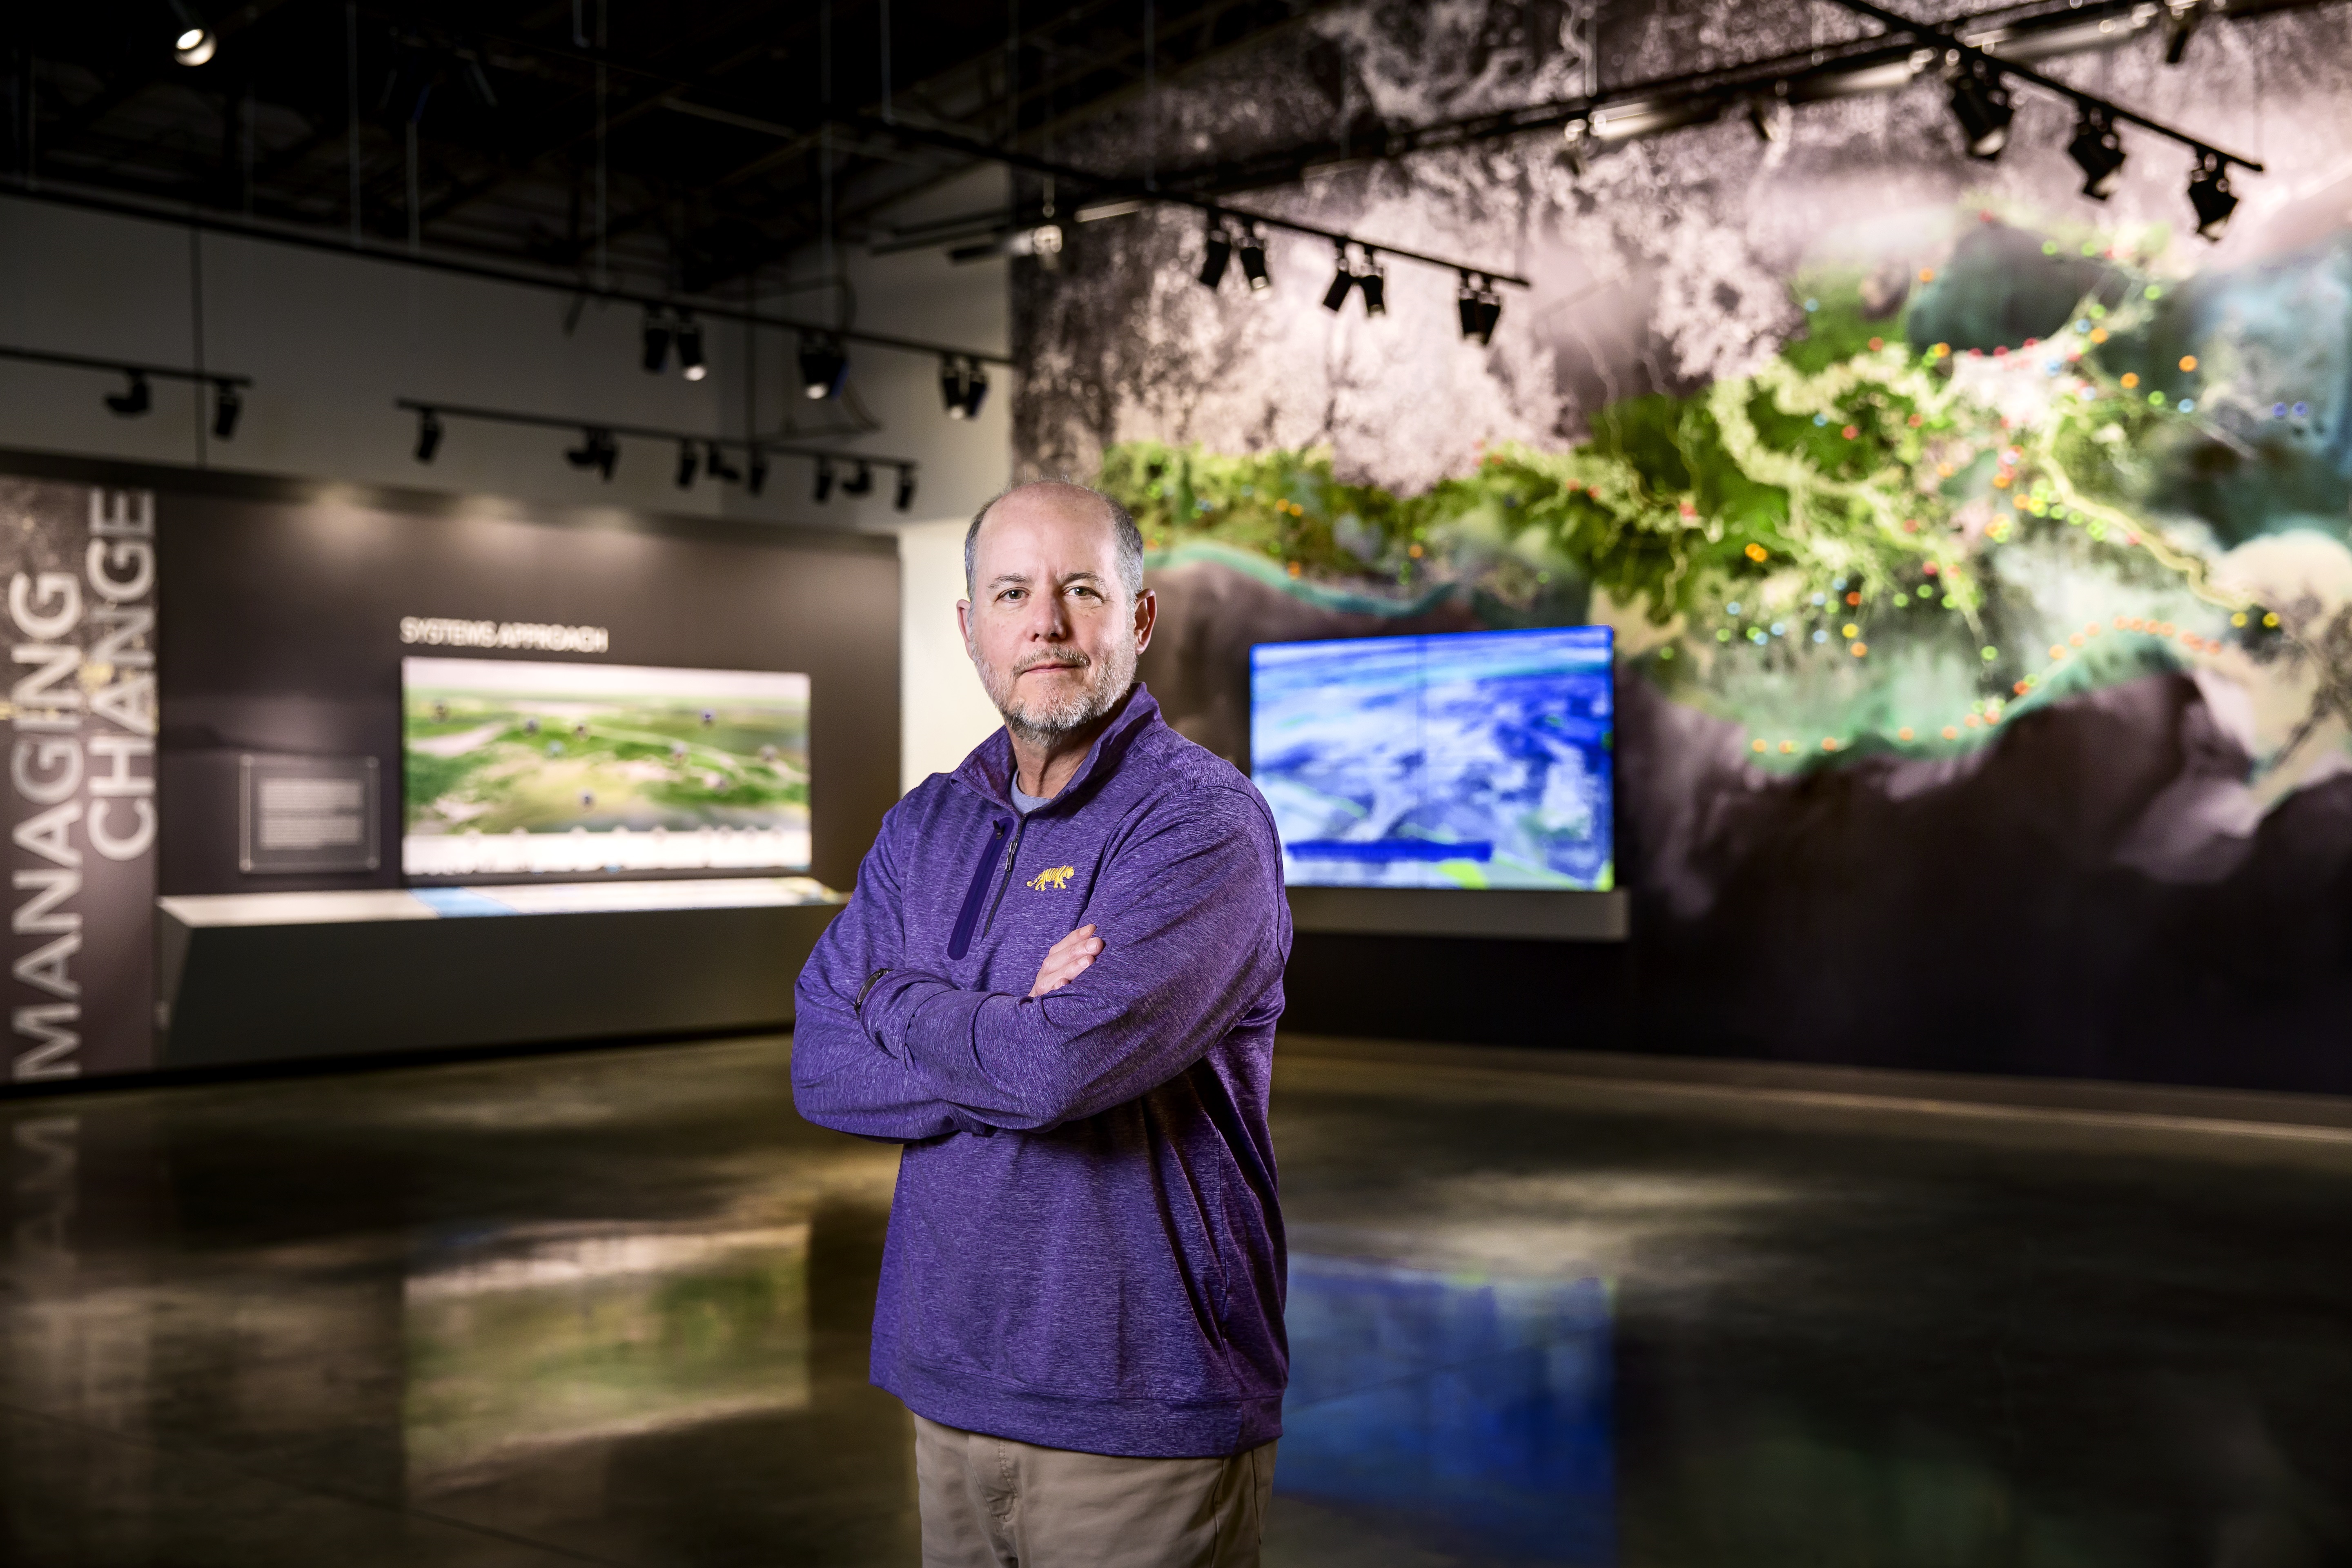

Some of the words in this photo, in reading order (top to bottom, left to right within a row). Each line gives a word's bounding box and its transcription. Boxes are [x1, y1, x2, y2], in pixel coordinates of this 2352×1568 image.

[87, 487, 158, 861] CHANGE
[400, 616, 497, 648] SYSTEMS
[498, 621, 609, 653] APPROACH
[10, 572, 83, 1082] MANAGING
